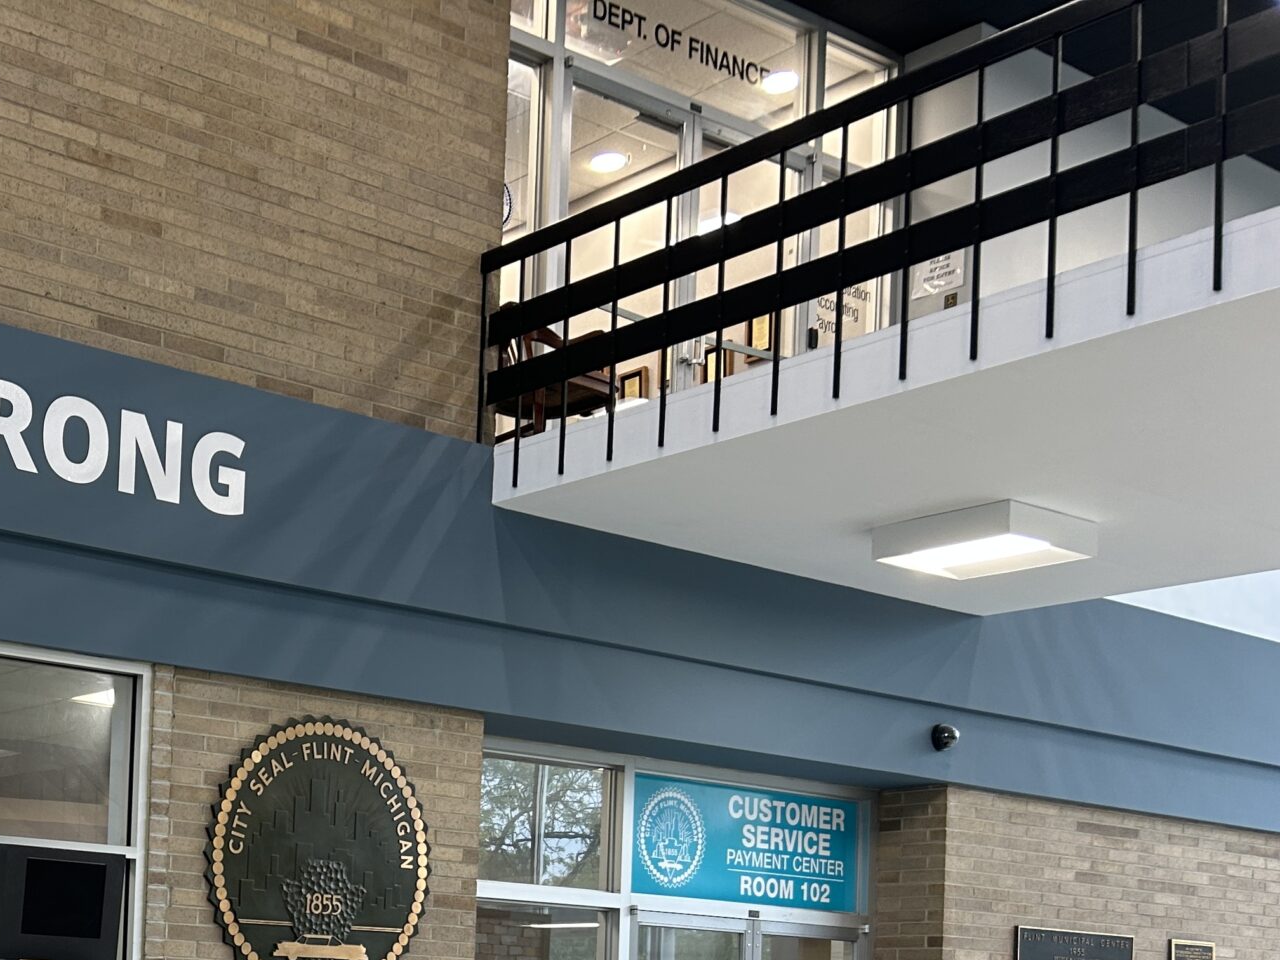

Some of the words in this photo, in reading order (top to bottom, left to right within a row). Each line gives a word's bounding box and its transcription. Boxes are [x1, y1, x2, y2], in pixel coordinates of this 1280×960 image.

[593, 0, 647, 41] DEPT.
[654, 24, 682, 52] OF
[228, 801, 252, 854] CITY
[728, 794, 845, 832] CUSTOMER
[741, 824, 831, 856] SERVICE
[726, 848, 790, 871] PAYMENT
[792, 856, 844, 877] CENTER
[306, 893, 342, 915] 1855
[740, 875, 794, 900] ROOM
[801, 882, 831, 903] 102
